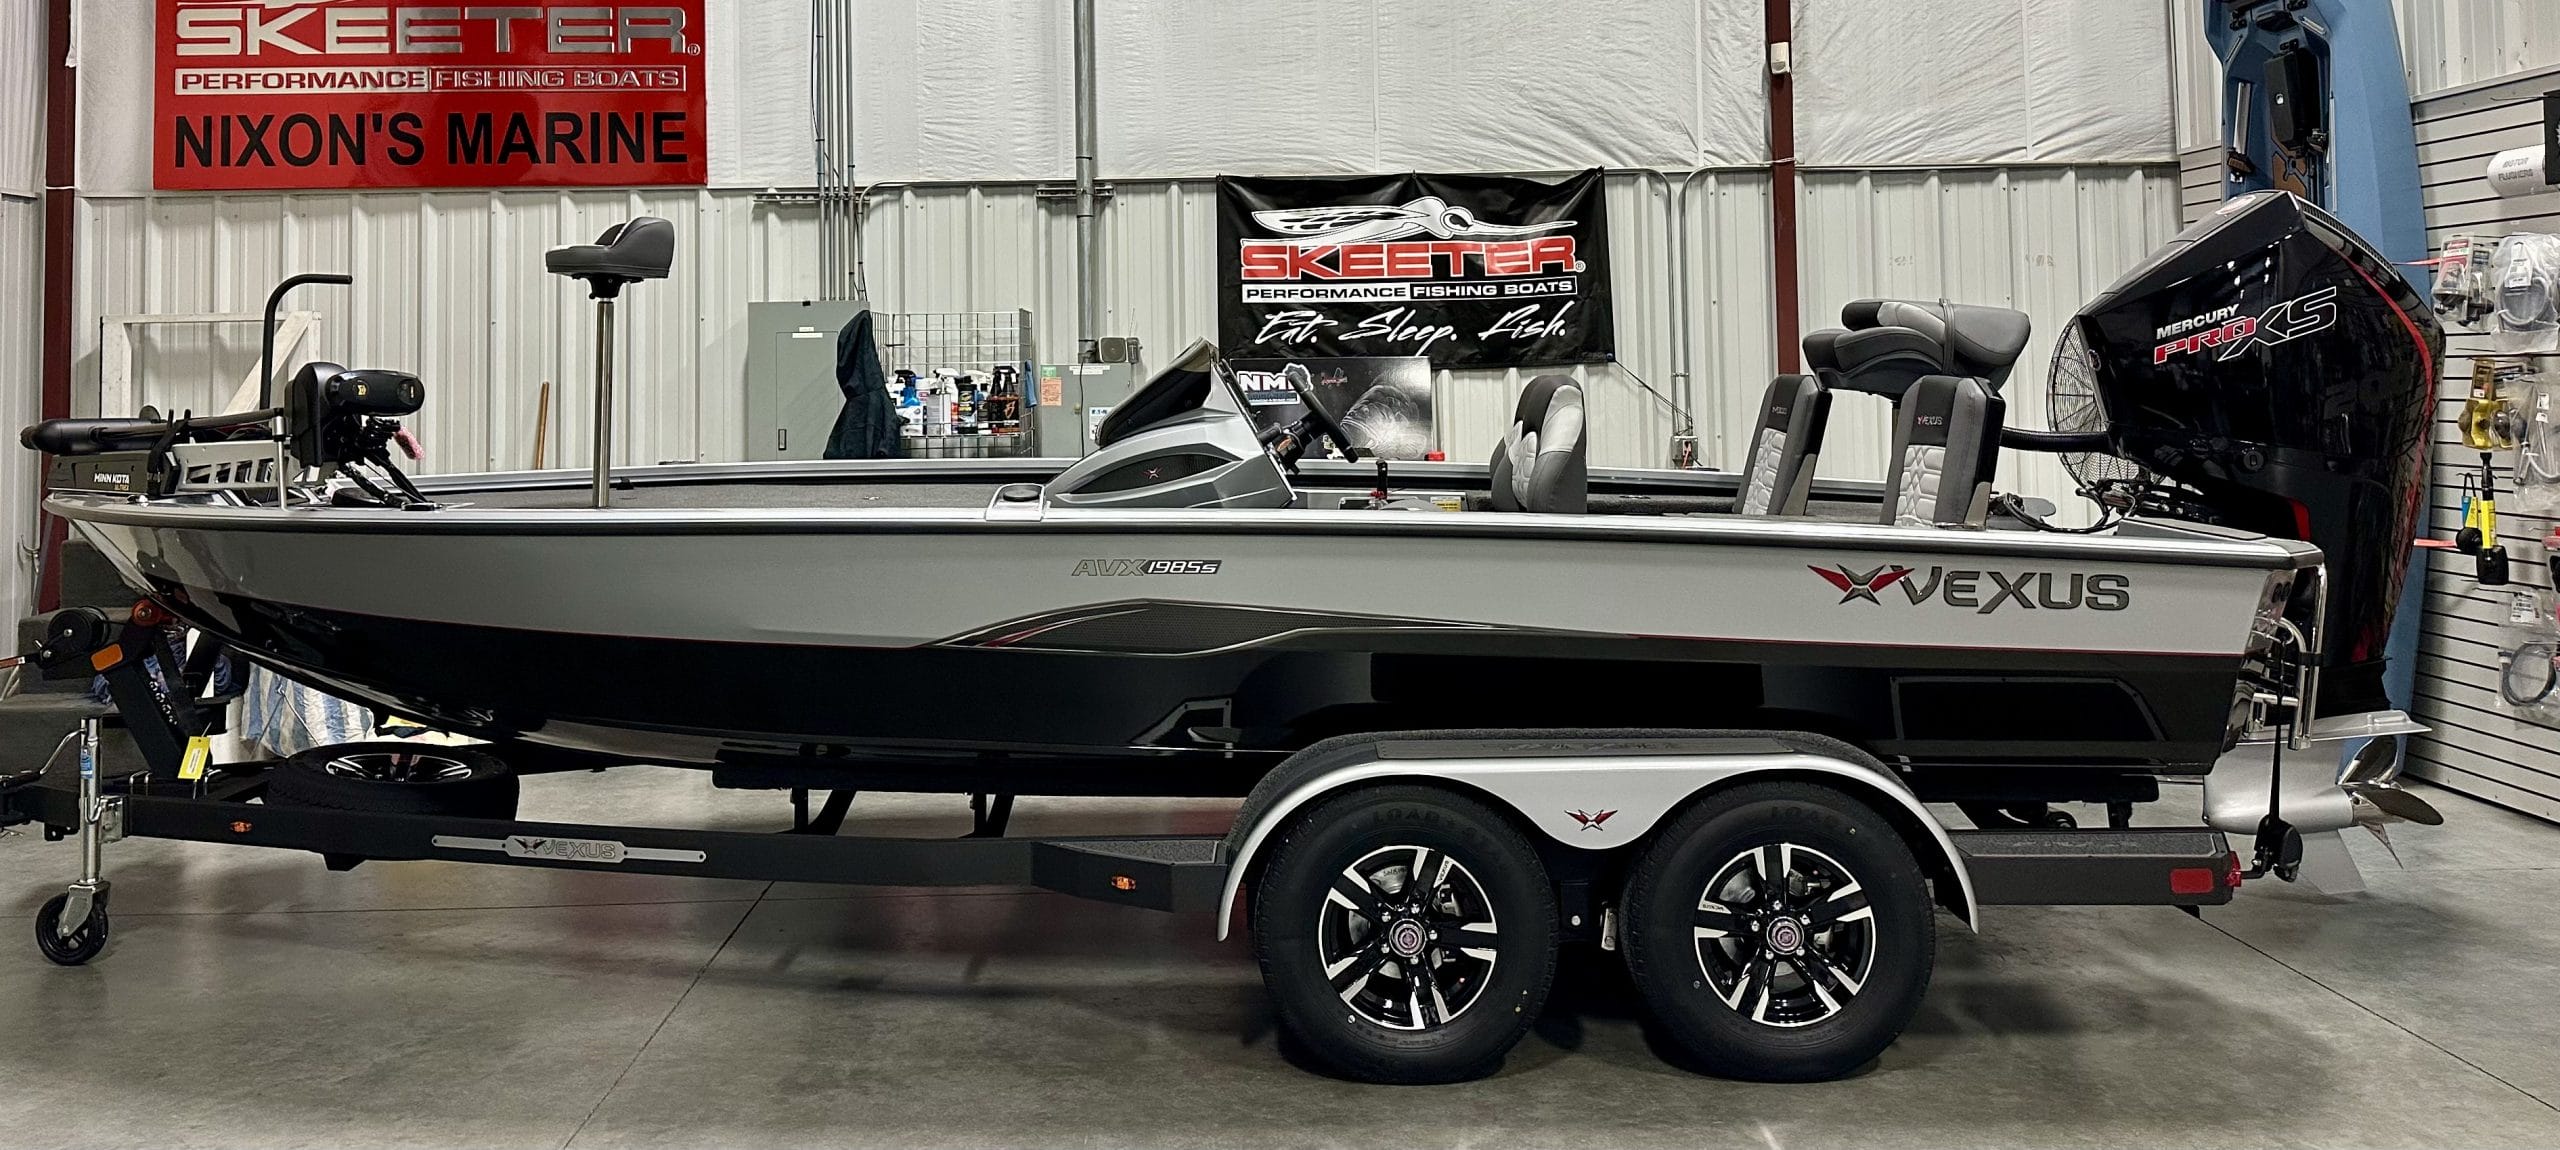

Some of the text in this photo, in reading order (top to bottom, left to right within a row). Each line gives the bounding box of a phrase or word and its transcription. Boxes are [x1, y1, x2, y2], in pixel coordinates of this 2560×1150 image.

[176, 7, 686, 56] SKEETER
[181, 70, 679, 90] PERFORMANCE FISHING BOATS
[174, 111, 688, 168] NIXON'S MARINE
[1241, 235, 1576, 280] SKEETER
[1246, 280, 1573, 299] PERFORMANCE FISHING BOATS
[1254, 300, 1575, 357] Eat. Sleep. Fish.
[2154, 316, 2258, 365] PRO
[2156, 303, 2240, 340] MERCURY
[94, 473, 130, 484] MINN KOTA
[1071, 559, 1146, 576] AVX
[1890, 565, 2130, 614] VEXUS
[542, 838, 616, 860] VEXUS
